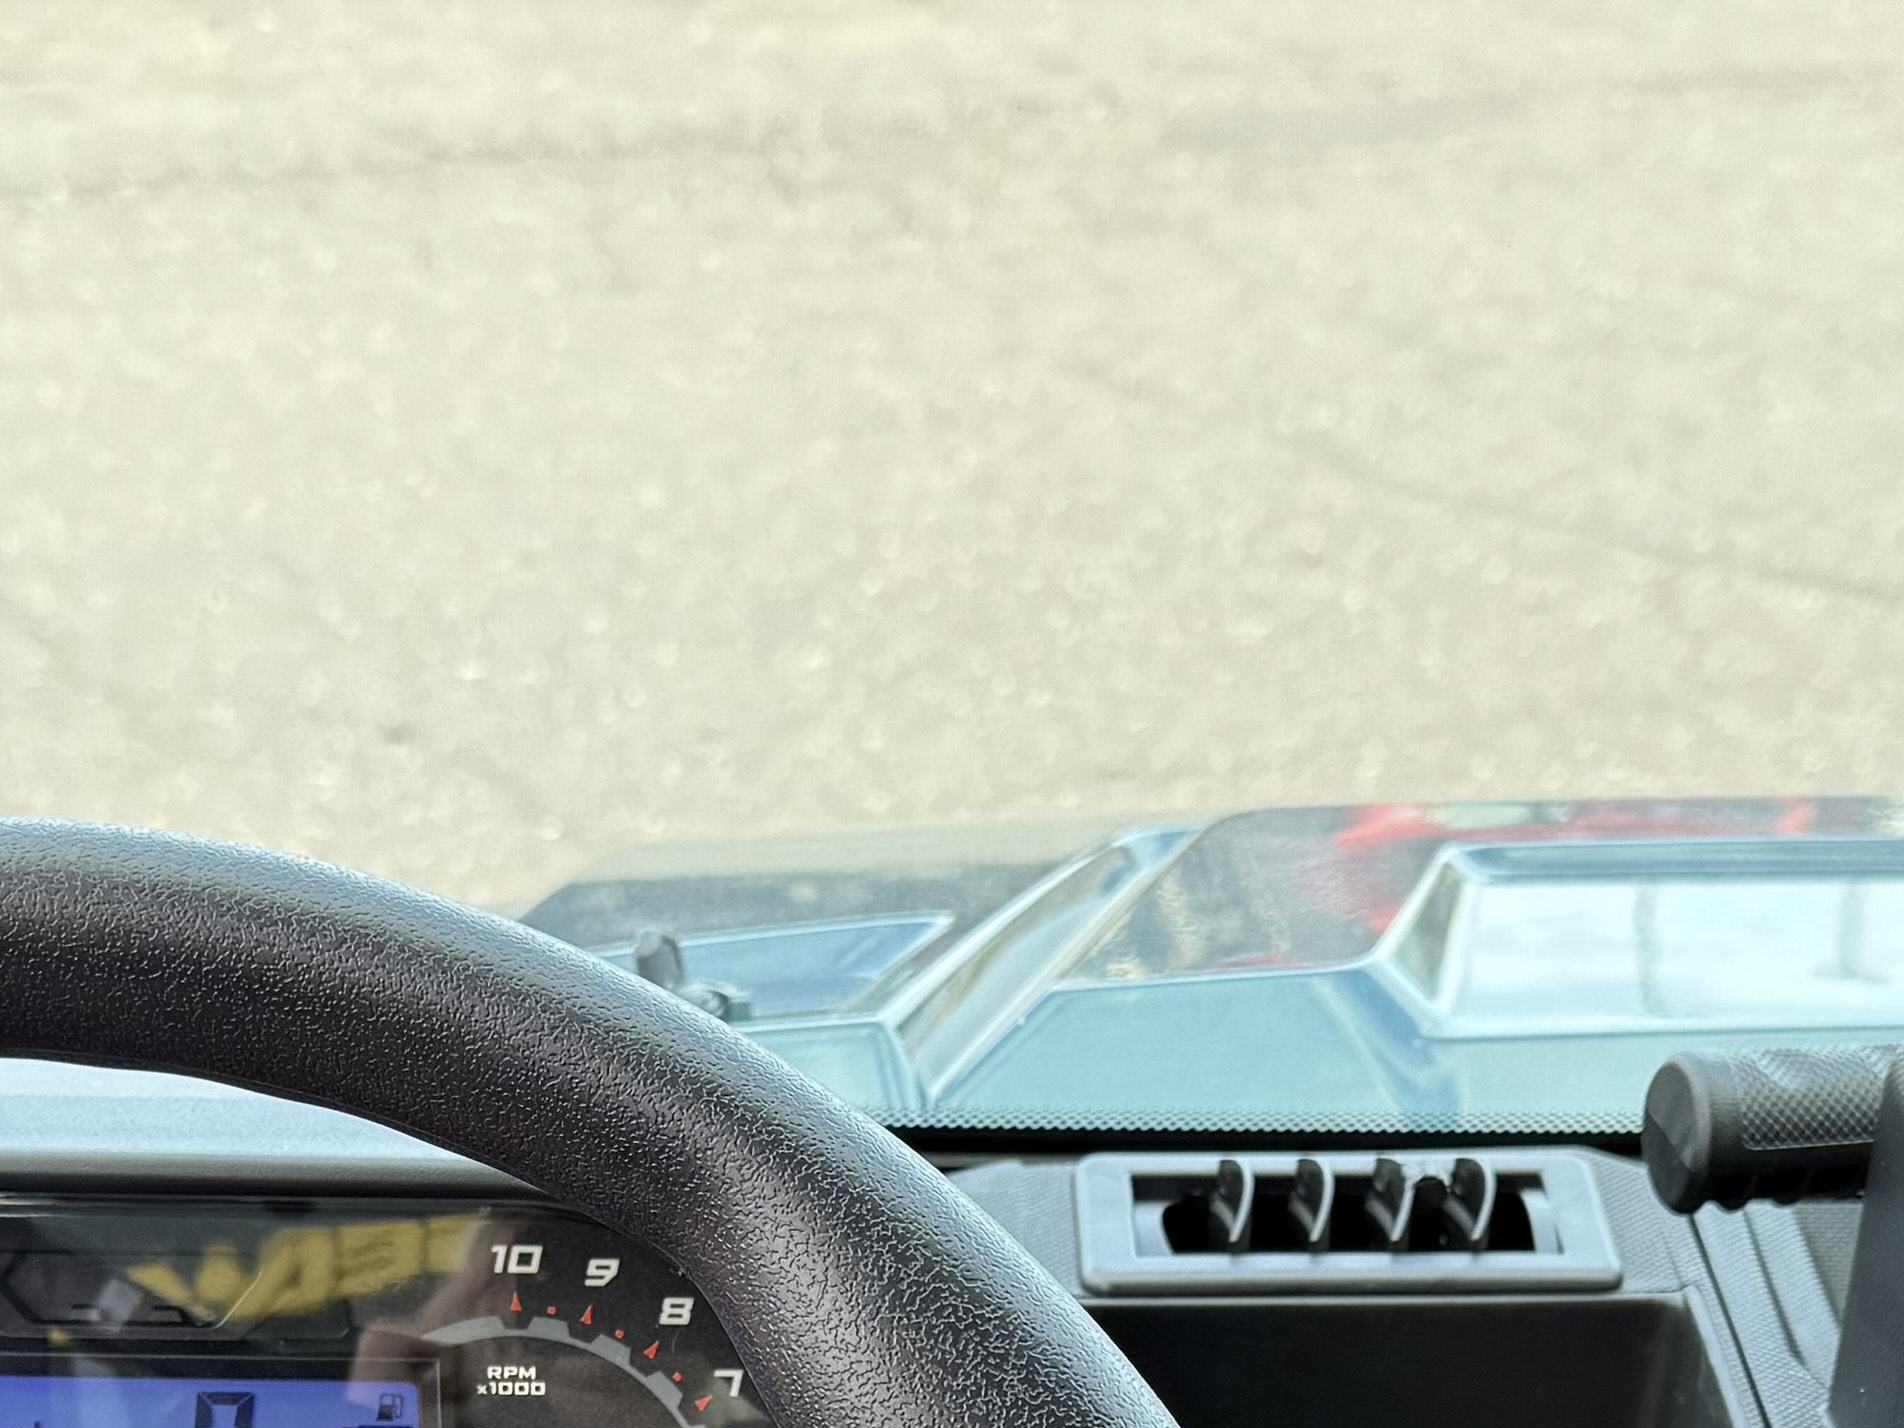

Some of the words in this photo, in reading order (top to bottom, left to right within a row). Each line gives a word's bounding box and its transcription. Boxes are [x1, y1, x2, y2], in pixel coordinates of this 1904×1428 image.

[491, 1245, 543, 1274] 10
[584, 1258, 620, 1287] 9
[659, 1297, 695, 1325] 8
[487, 1365, 537, 1380] RPM
[713, 1369, 745, 1397] 7
[476, 1381, 546, 1396] x1000
